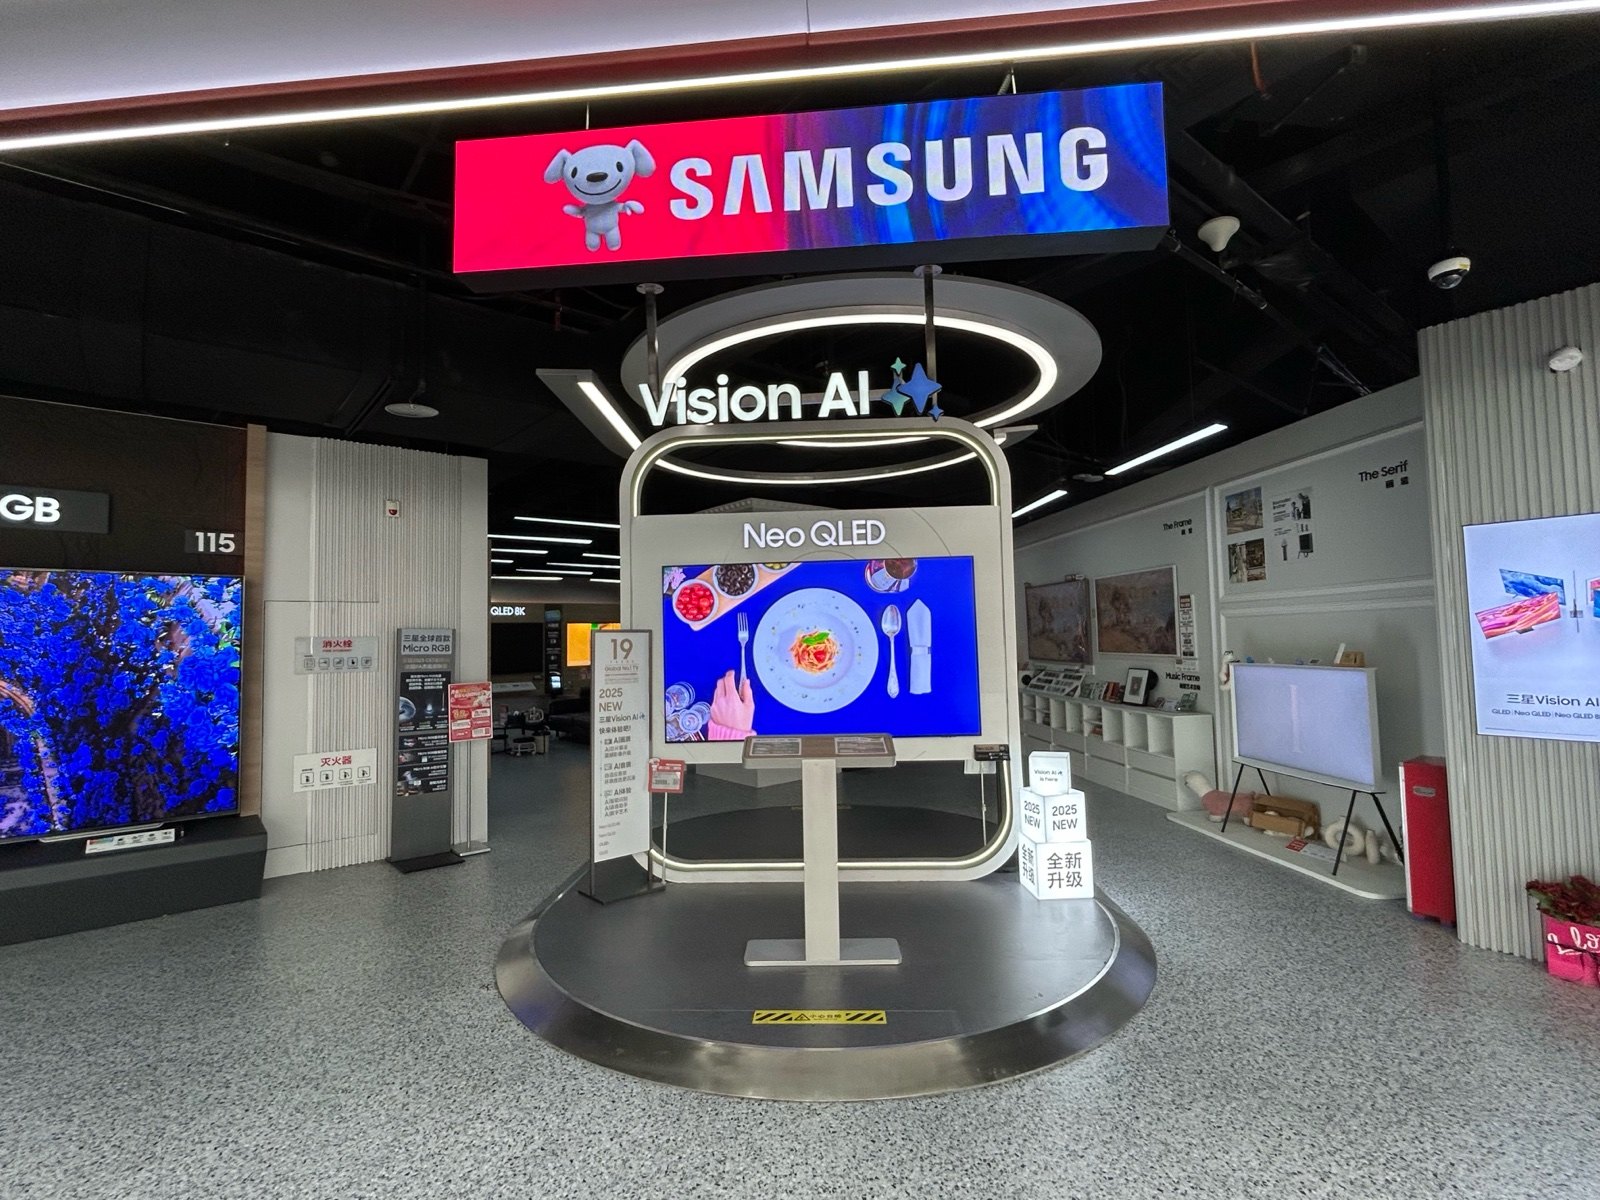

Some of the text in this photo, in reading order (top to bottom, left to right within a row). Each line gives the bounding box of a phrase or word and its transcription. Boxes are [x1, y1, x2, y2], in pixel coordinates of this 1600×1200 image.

[669, 126, 1110, 220] SAMSUNG
[638, 370, 871, 427] Vision AI
[1358, 460, 1408, 482] The Serif
[0, 493, 61, 523] GB
[1163, 518, 1192, 531] The Frame
[743, 519, 886, 549] Neo QLED
[195, 531, 236, 553] 115
[490, 606, 526, 616] QLED 8K
[322, 639, 353, 649] 消火栓
[402, 643, 451, 653] Micro RGB
[610, 638, 633, 660] 19
[1165, 672, 1200, 682] Music Frame
[599, 687, 623, 698] 2025
[1506, 693, 1599, 707] 三星Vision AI
[598, 701, 623, 713] NEW
[632, 713, 639, 721] AI
[1531, 710, 1551, 718] QLED
[1572, 712, 1593, 720] QLED
[320, 755, 352, 767] 灭火器
[1024, 800, 1041, 815] 2025
[1052, 804, 1078, 816] 2025
[1024, 814, 1041, 830] NEW
[1052, 818, 1078, 831] NEW
[1047, 852, 1082, 870] 全新
[1047, 871, 1083, 889] 升级
